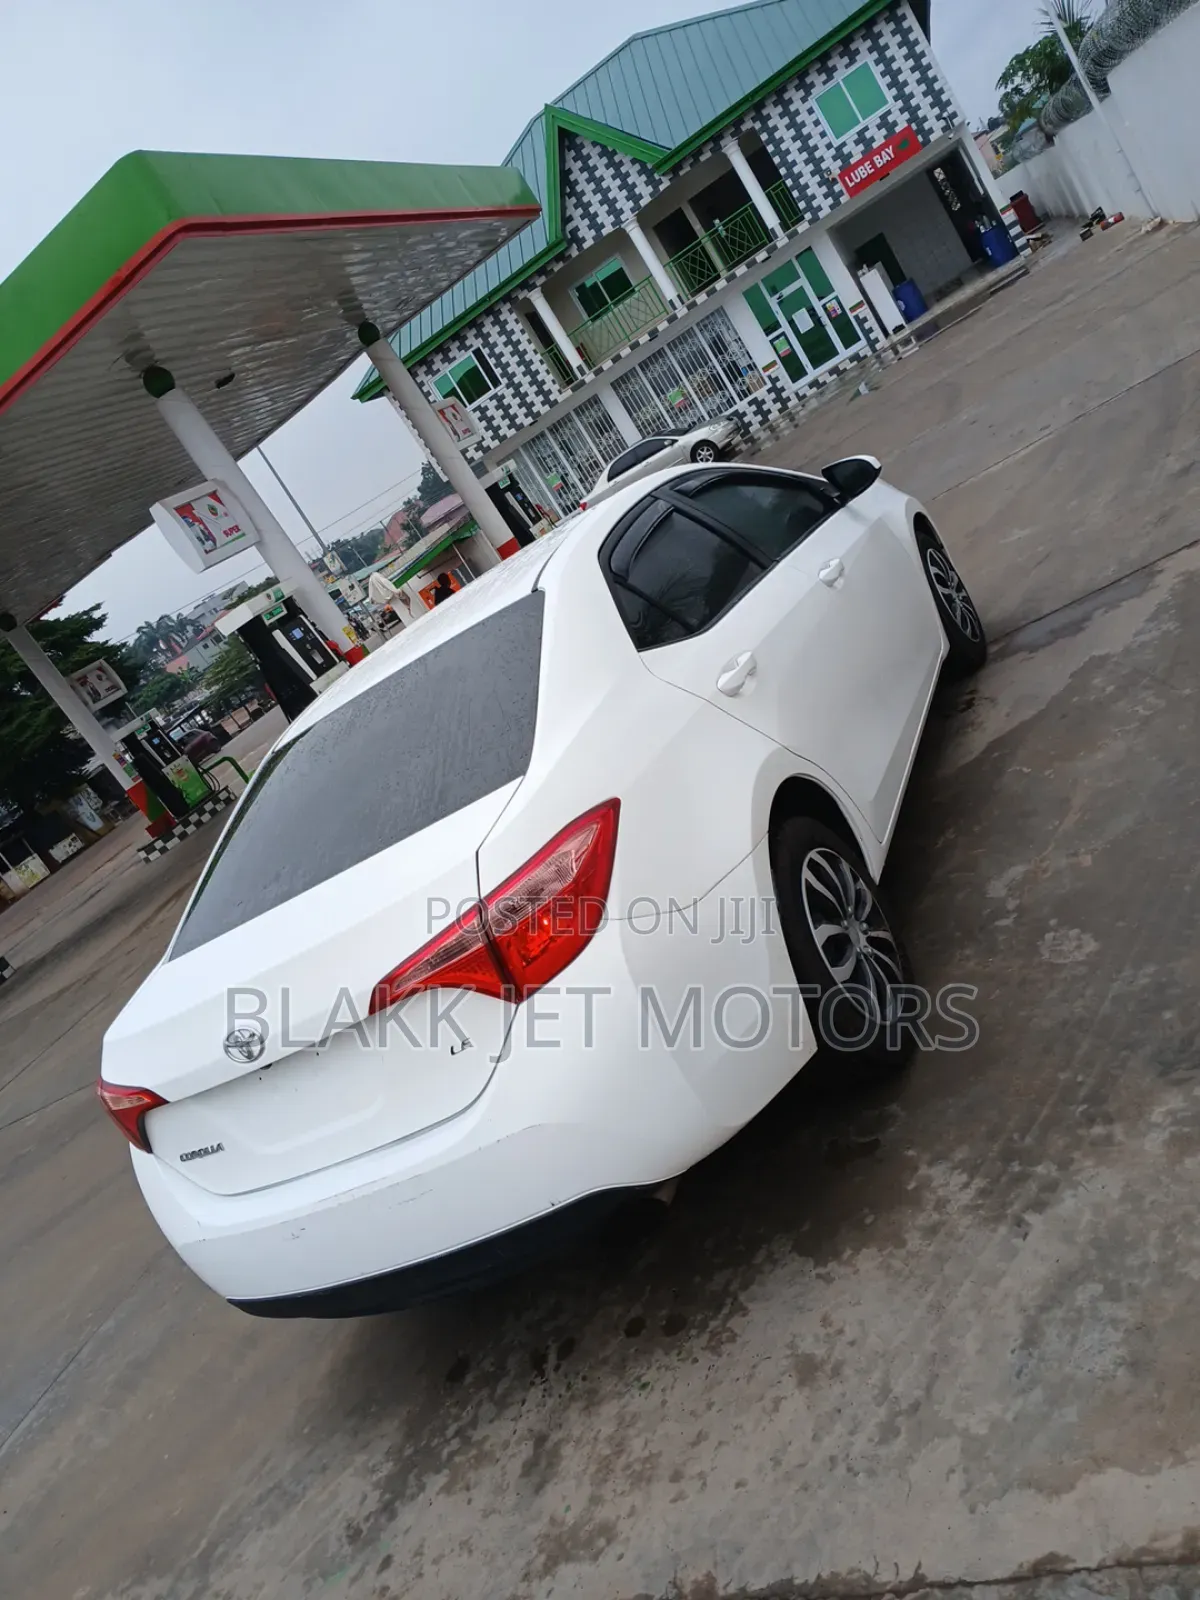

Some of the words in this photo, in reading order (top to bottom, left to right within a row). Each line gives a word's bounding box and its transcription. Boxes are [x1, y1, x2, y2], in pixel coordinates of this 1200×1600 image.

[844, 160, 875, 188] LUBE
[873, 145, 895, 168] BAY
[179, 1142, 225, 1162] COROLLA
